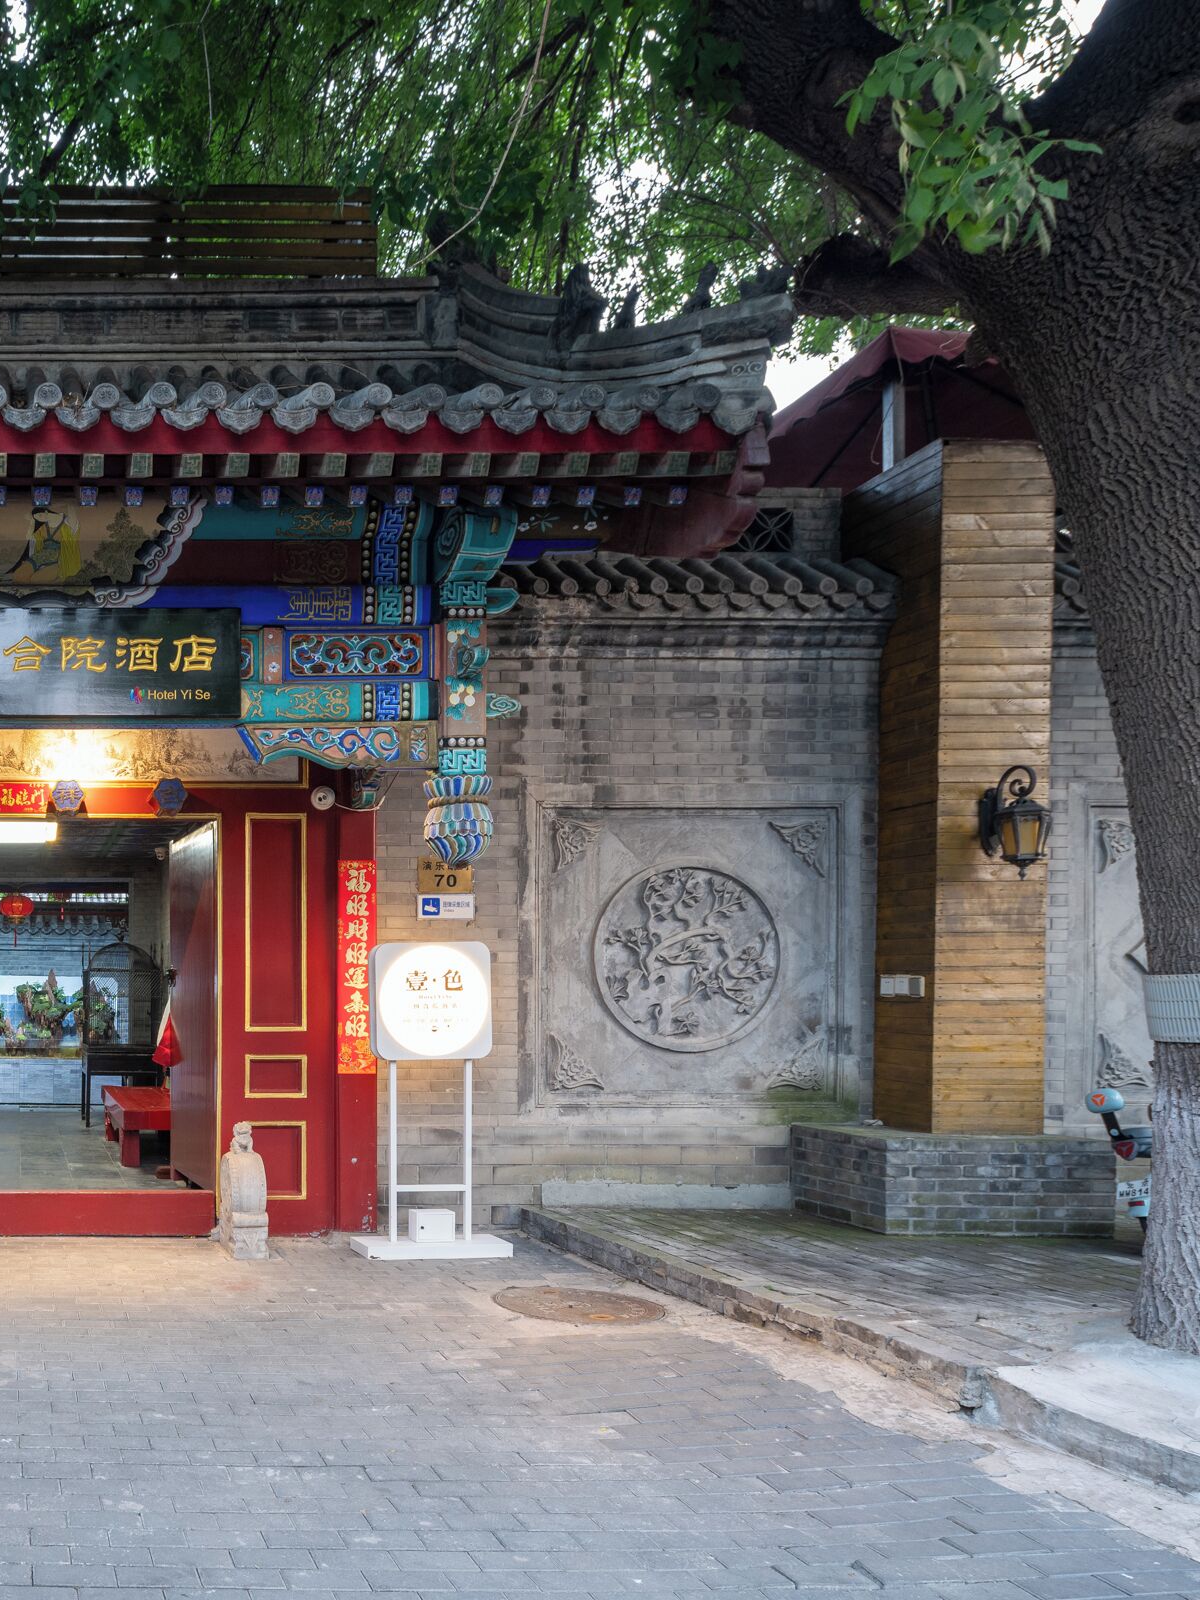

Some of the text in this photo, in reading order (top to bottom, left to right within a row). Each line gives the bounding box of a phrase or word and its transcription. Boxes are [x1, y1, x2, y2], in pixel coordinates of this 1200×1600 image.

[147, 689, 211, 700] Hotel Yi Se
[57, 785, 80, 803] 祥
[423, 861, 469, 871] 演乐
[434, 874, 457, 888] 70
